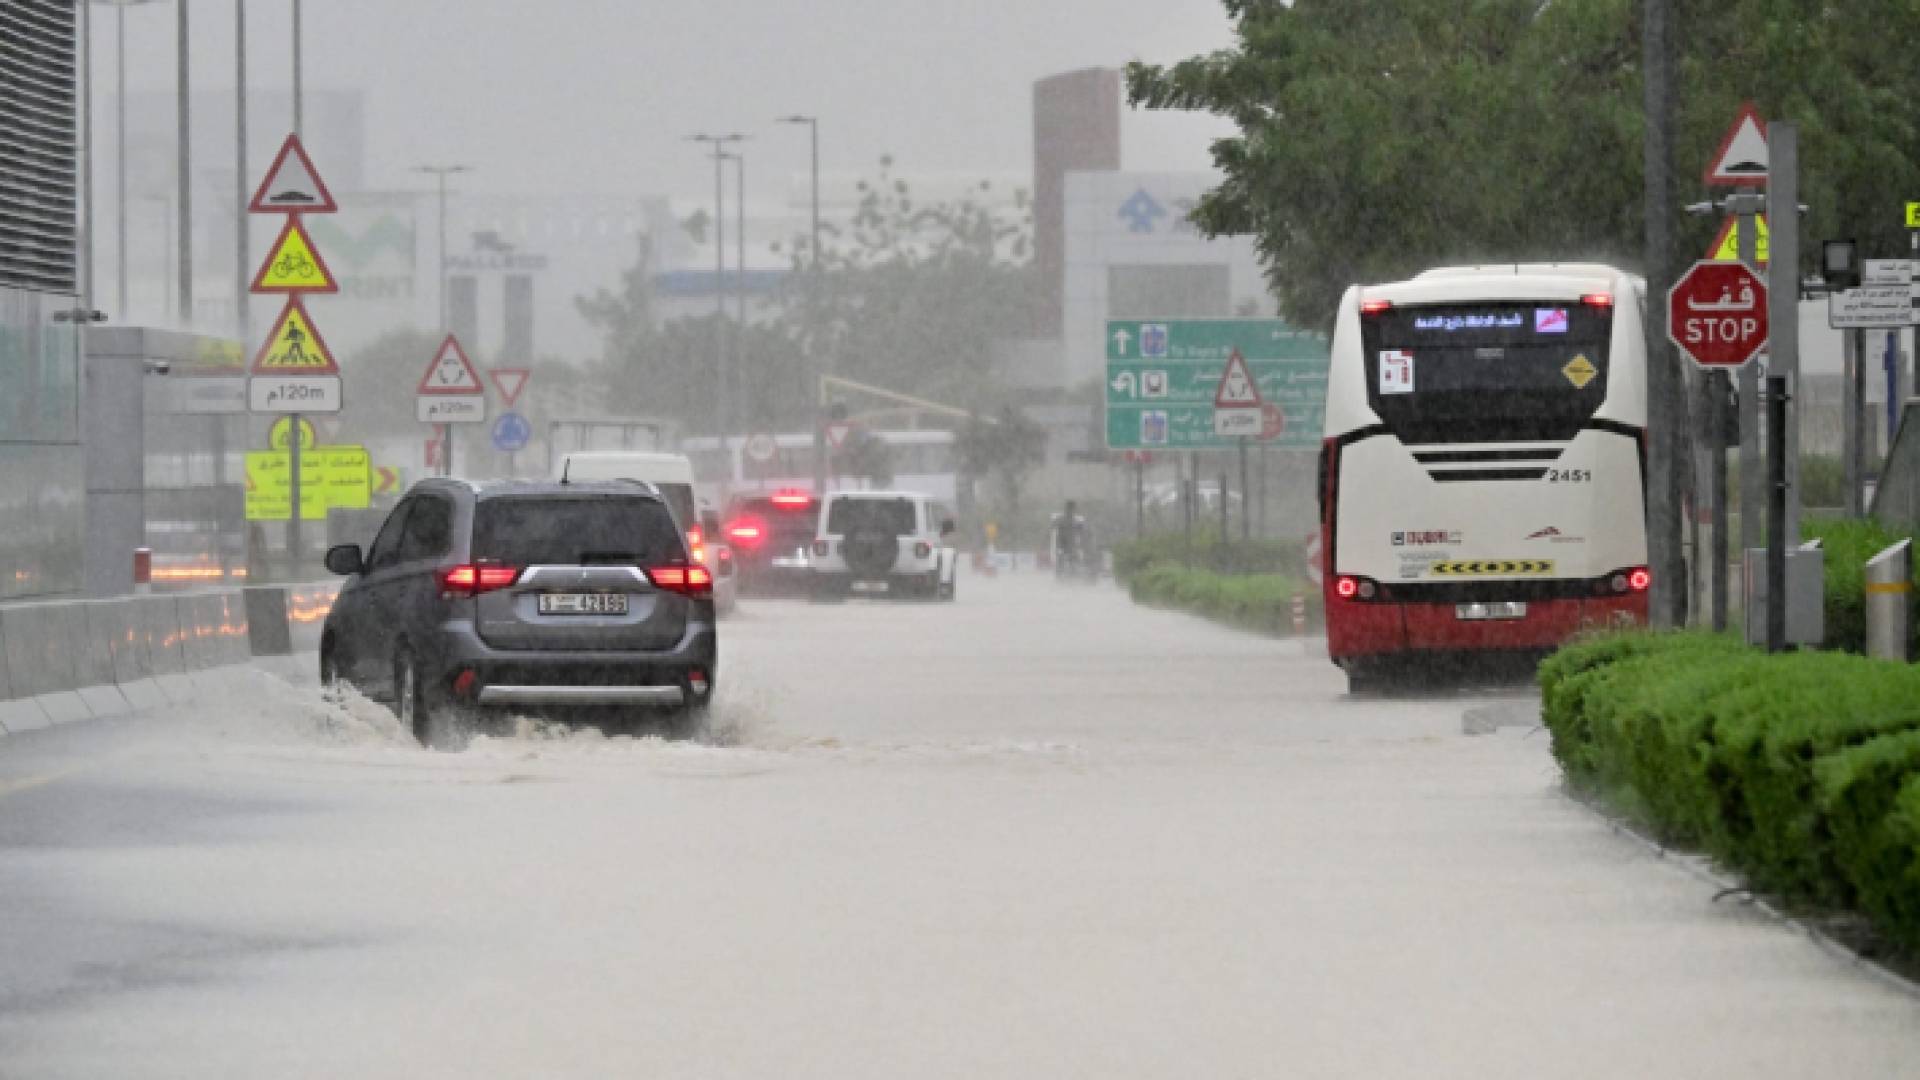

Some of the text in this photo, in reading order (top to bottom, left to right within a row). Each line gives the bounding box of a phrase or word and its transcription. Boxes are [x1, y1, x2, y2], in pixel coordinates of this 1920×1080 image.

[1688, 278, 1754, 310] قف
[1686, 318, 1756, 342] STOP
[1550, 469, 1591, 482] 2451
